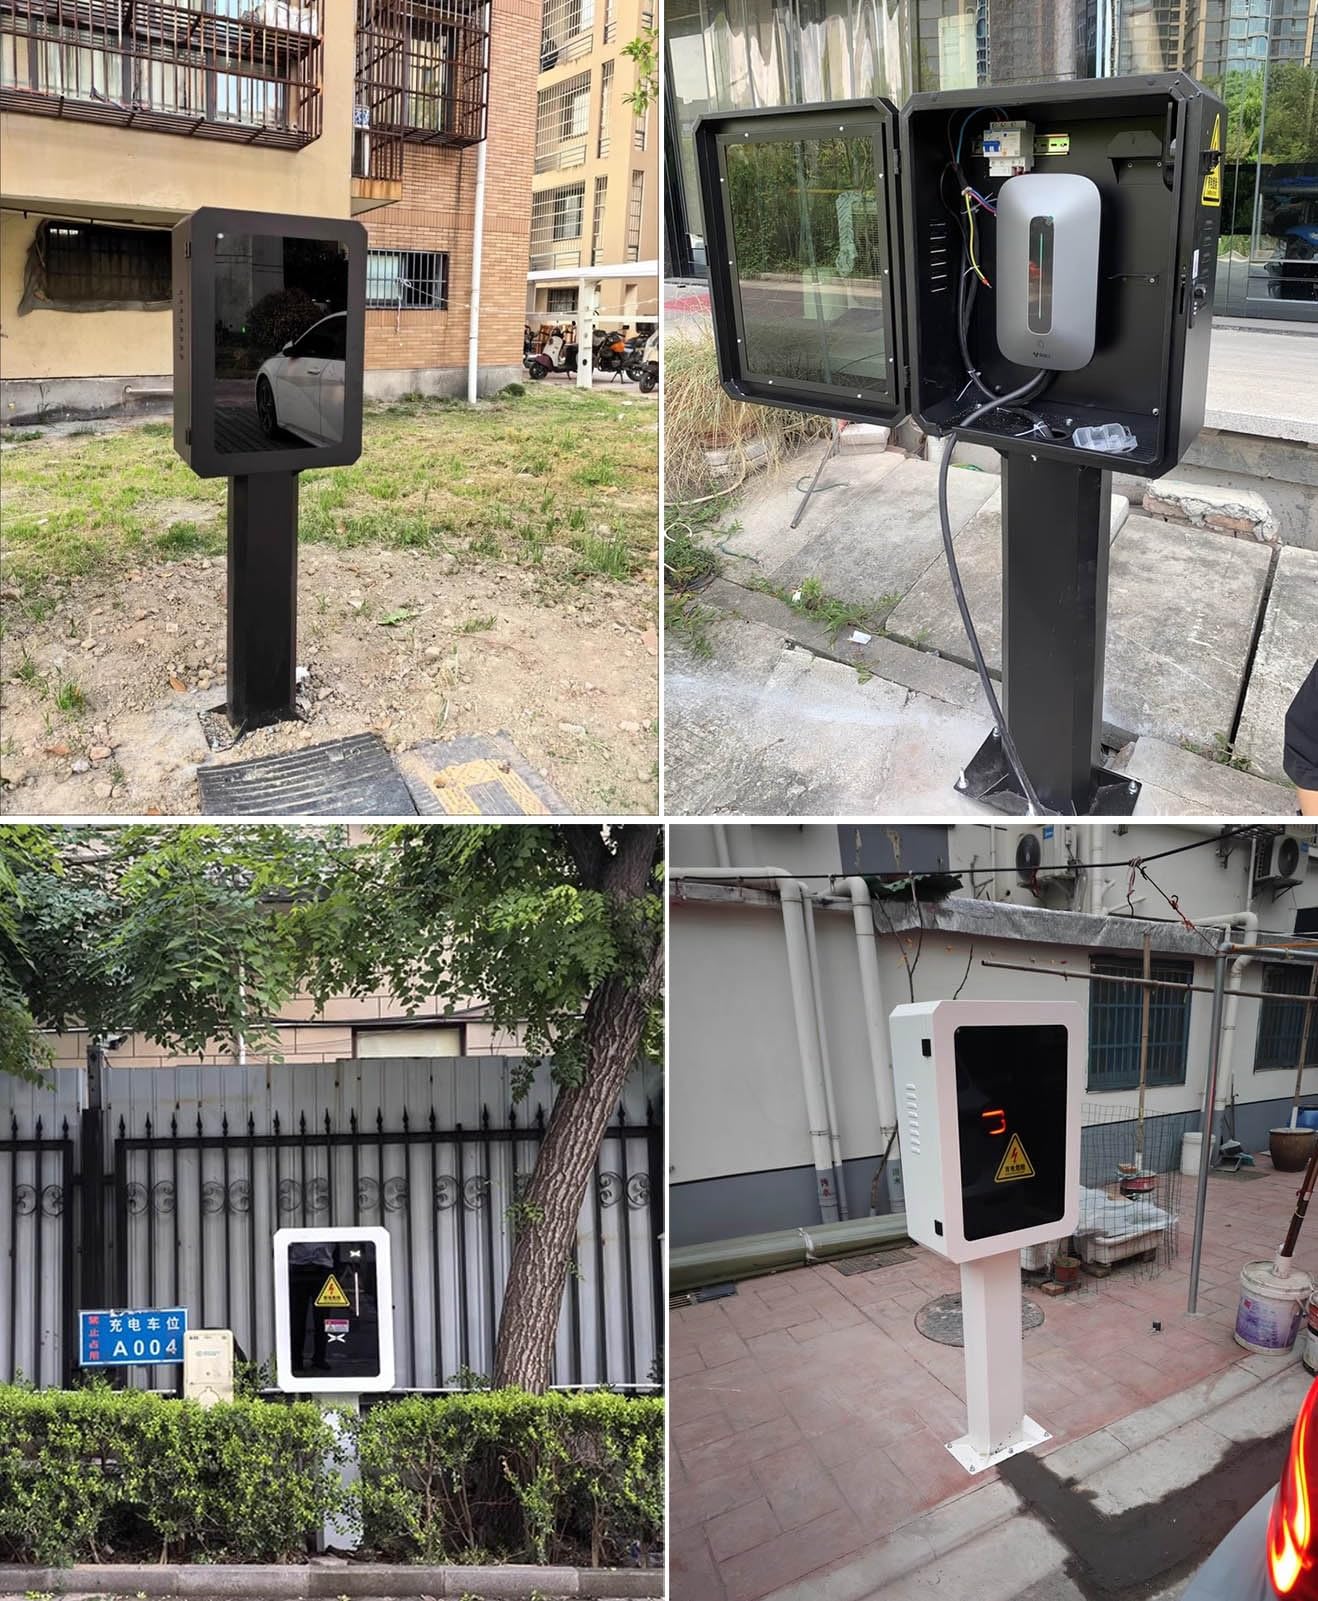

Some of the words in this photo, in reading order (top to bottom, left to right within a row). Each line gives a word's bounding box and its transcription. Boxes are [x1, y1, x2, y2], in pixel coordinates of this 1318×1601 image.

[109, 1316, 180, 1333] 充电车位
[113, 1338, 177, 1356] A004
